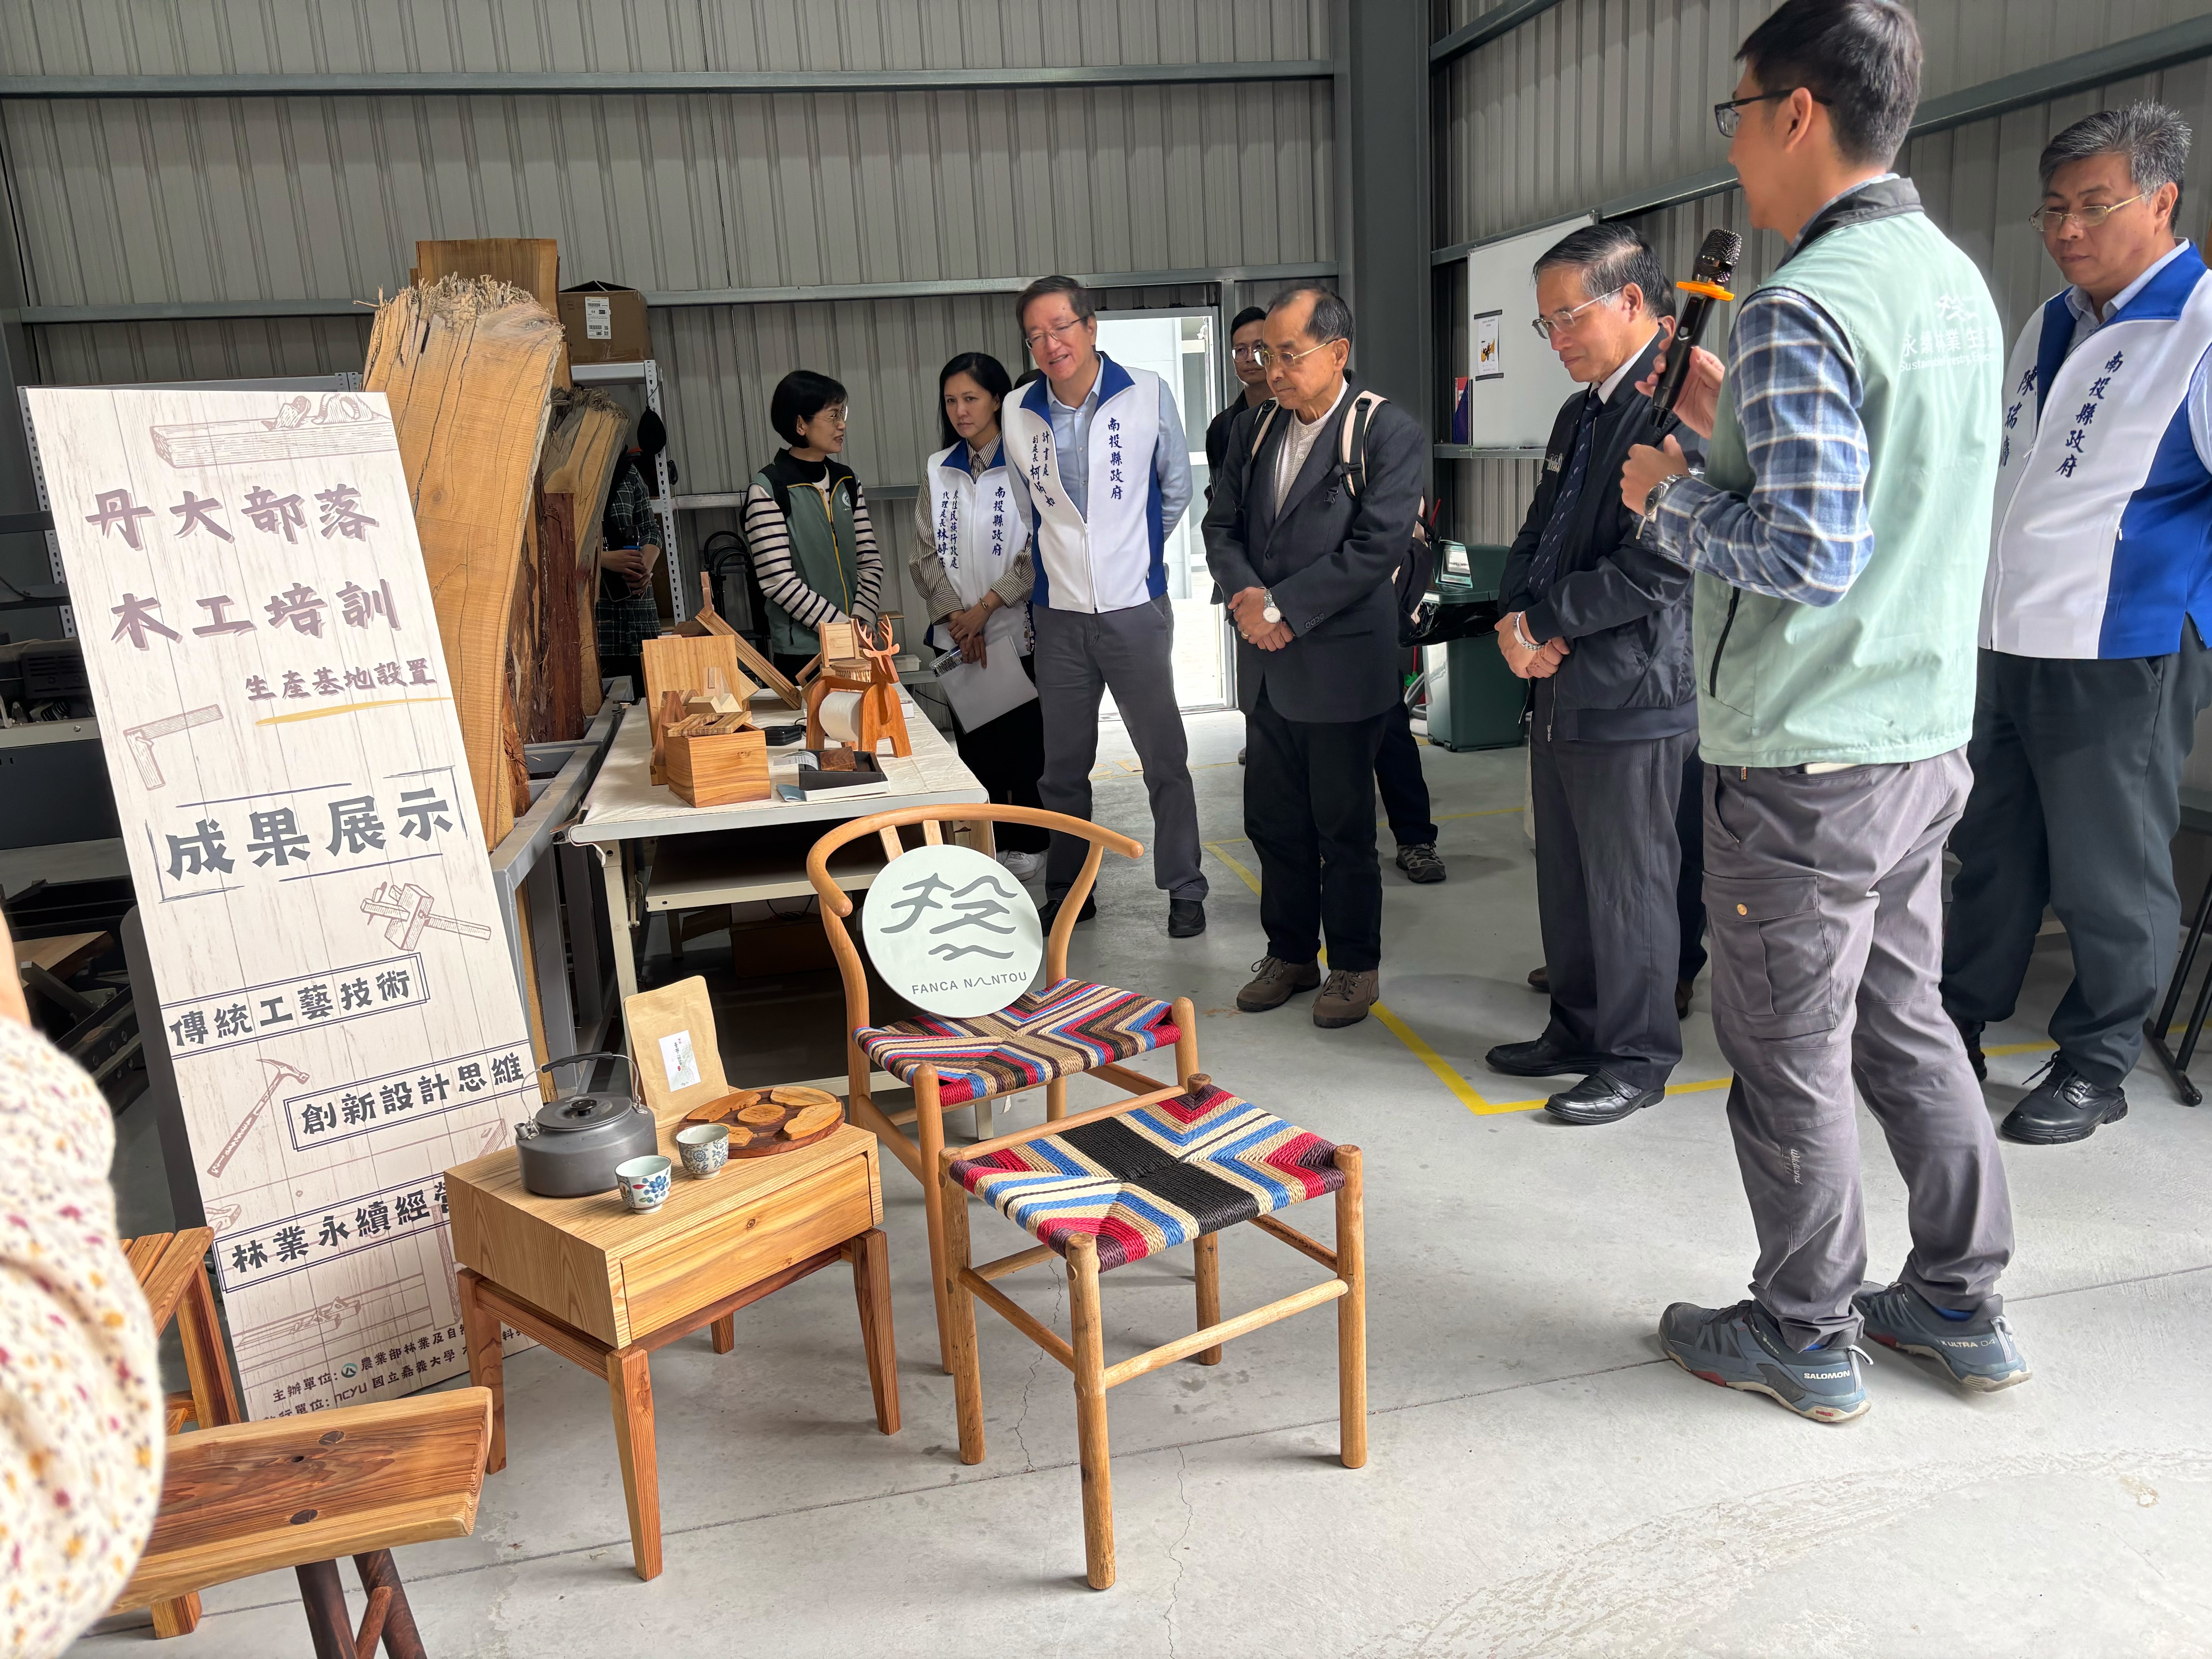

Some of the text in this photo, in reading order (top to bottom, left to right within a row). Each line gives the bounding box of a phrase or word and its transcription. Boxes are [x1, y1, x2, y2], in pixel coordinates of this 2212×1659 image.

[2055, 350, 2124, 478] 南投縣政府
[1108, 417, 1124, 500] 南投縣政府
[85, 484, 379, 551] 丹大部落
[992, 486, 1005, 556] 南投縣政府
[110, 579, 403, 650] 木工培訓
[246, 658, 436, 702] 生產基地設置
[166, 788, 454, 879] 成果展示
[169, 970, 411, 1046] 傳統工藝技術
[912, 980, 958, 994] FANCA
[301, 1054, 524, 1135] 創新設計思維
[263, 1399, 330, 1420] 行單位：
[373, 1350, 455, 1389] 國立嘉義大學
[1804, 1370, 1850, 1380] SALOMON
